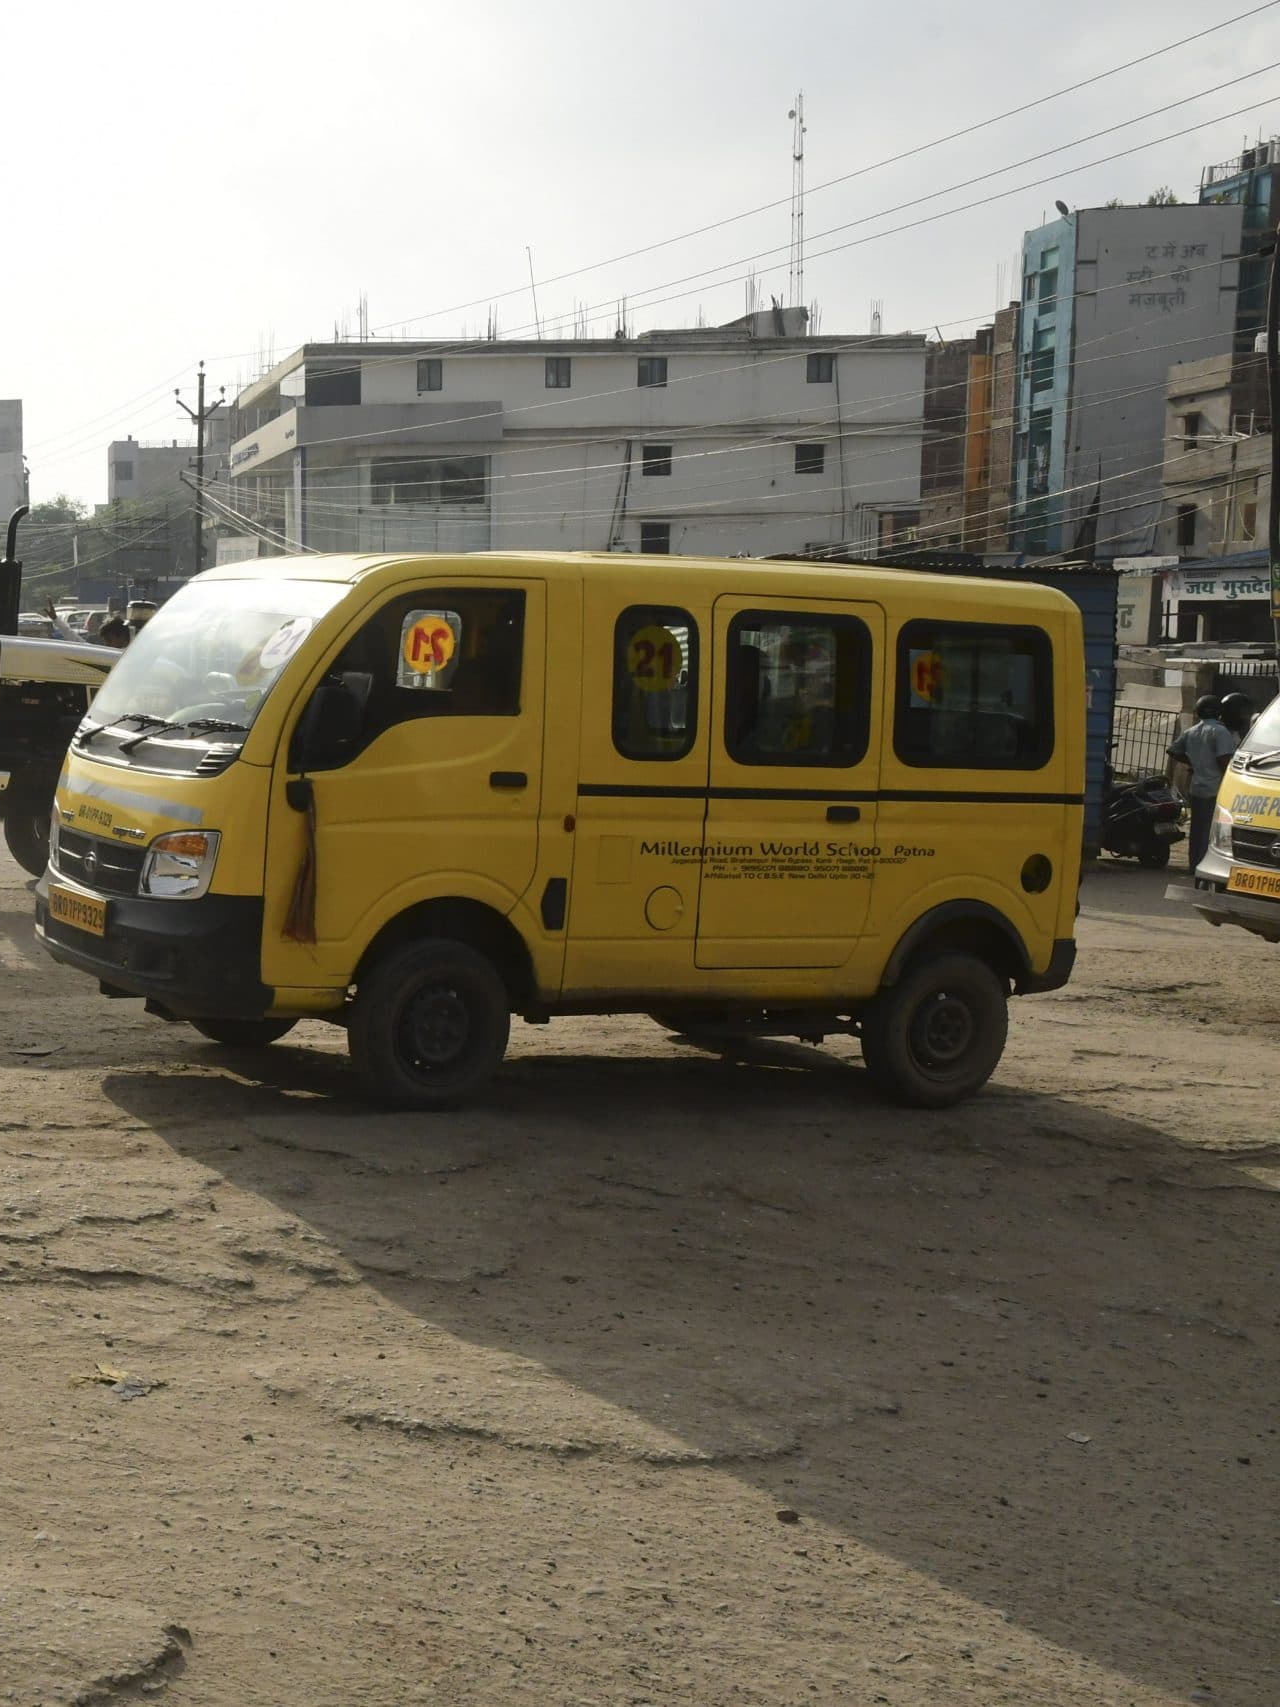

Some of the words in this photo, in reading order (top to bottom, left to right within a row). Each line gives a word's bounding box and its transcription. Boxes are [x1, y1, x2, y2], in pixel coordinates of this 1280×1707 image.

[1184, 580, 1217, 595] जय
[266, 629, 307, 656] 21
[634, 639, 674, 680] 21
[1232, 794, 1267, 814] DESIRE
[640, 841, 753, 857] Millennium
[759, 841, 820, 857] World
[894, 844, 936, 857] Patna
